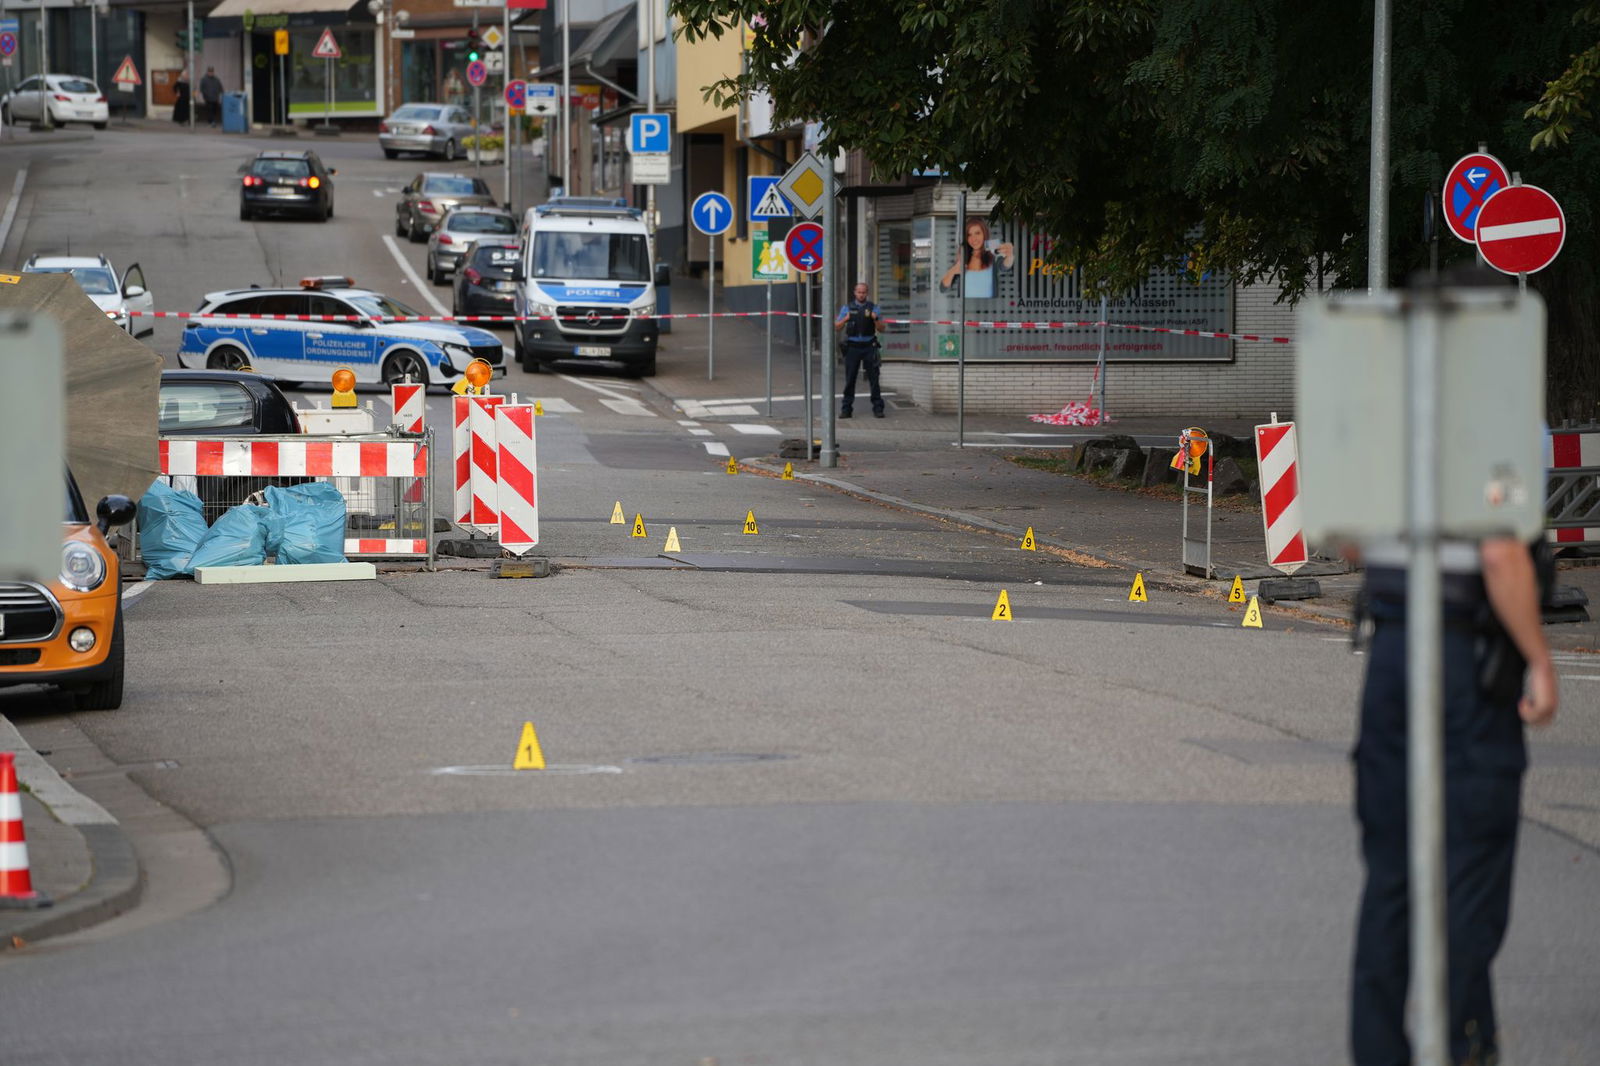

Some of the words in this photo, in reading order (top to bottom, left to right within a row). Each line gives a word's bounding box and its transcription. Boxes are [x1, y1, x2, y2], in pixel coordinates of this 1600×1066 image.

[641, 119, 661, 148] P
[566, 289, 620, 298] POLIZEI
[1017, 299, 1083, 310] Anmeldung
[1107, 298, 1126, 307] alle
[1130, 298, 1175, 307] Klassen
[313, 340, 366, 348] POLIZEILICHER
[1054, 343, 1100, 351] freundlich
[1113, 343, 1163, 352] erfolgreich
[306, 347, 371, 357] ORDNUNGSDIENST
[636, 525, 642, 534] 8
[746, 522, 755, 531] 10
[1025, 538, 1031, 547] 9
[1135, 586, 1141, 597] 4
[1234, 588, 1240, 599] 5
[999, 605, 1005, 616] 2
[1250, 610, 1256, 621] 3
[526, 744, 532, 762] 1
